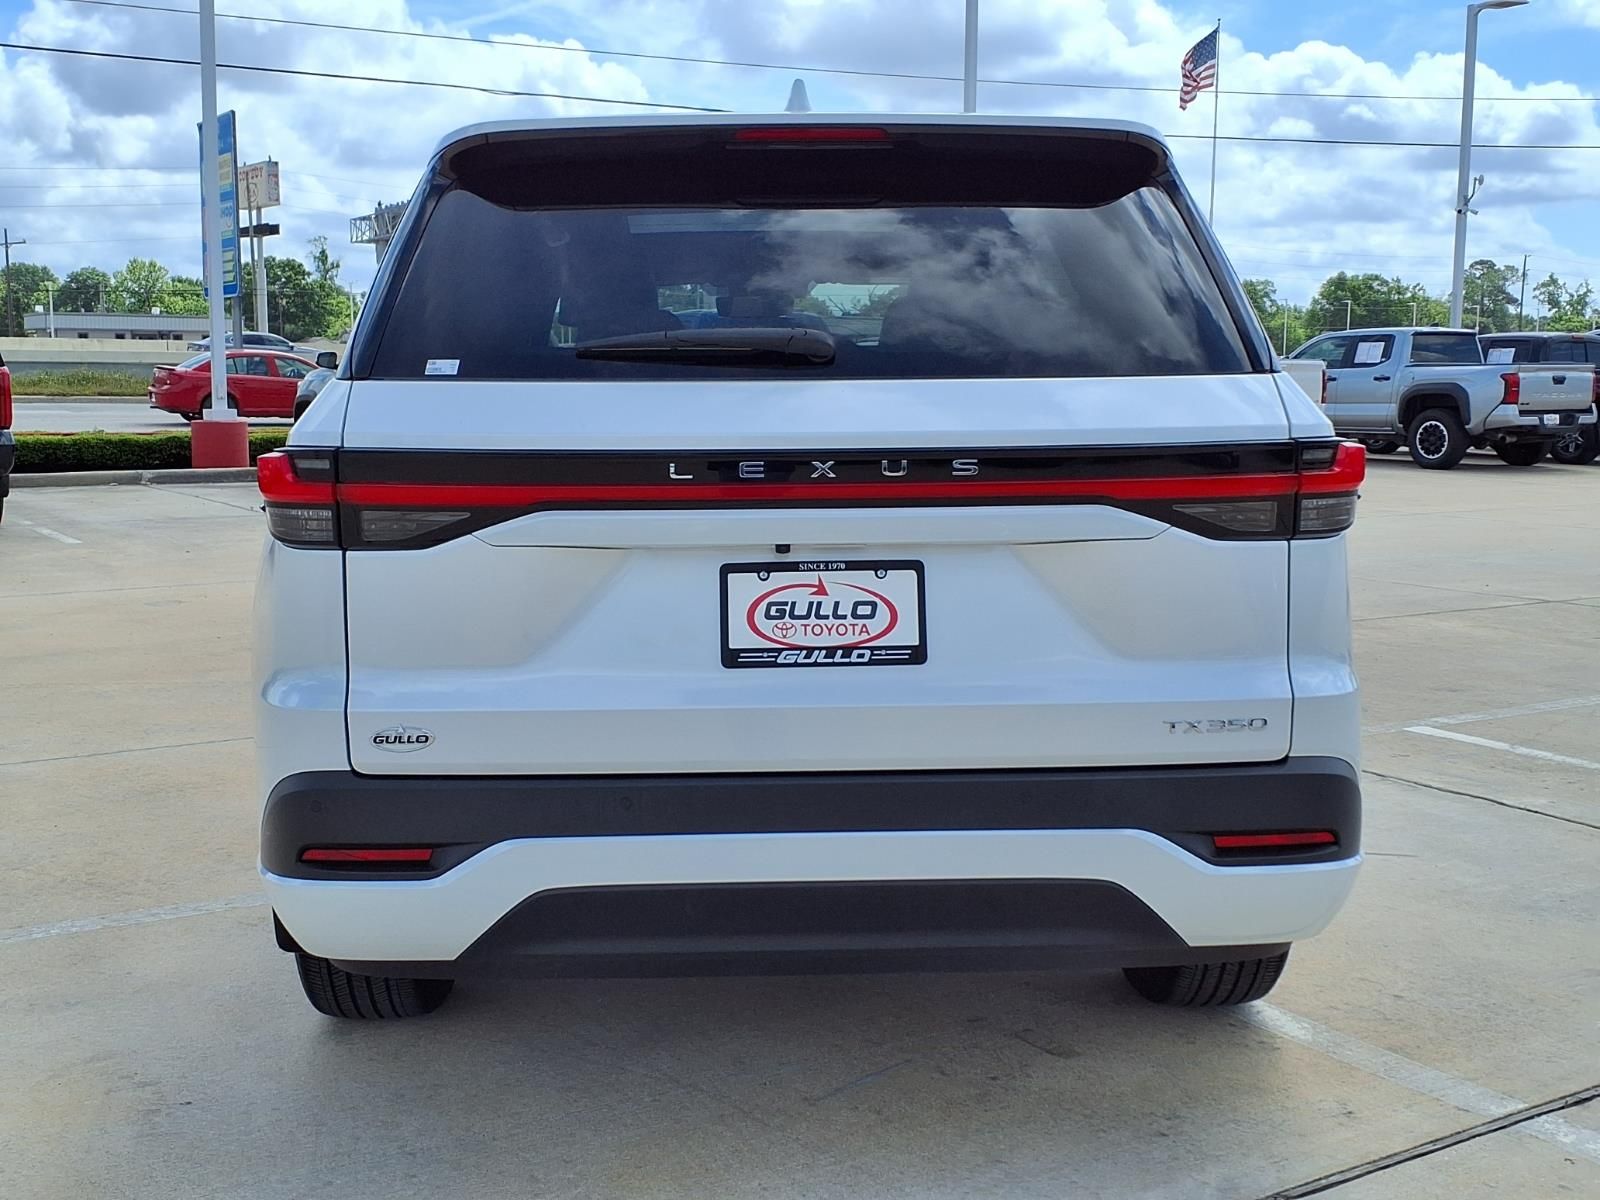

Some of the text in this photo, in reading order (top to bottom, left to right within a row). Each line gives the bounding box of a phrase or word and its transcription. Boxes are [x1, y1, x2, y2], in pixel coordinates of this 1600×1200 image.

[669, 459, 979, 479] LEXUS
[799, 562, 846, 571] SINCE 1970
[763, 600, 878, 621] GULLO
[801, 623, 871, 636] TOYOTA
[776, 650, 871, 663] GULLO
[372, 734, 430, 745] GULLO
